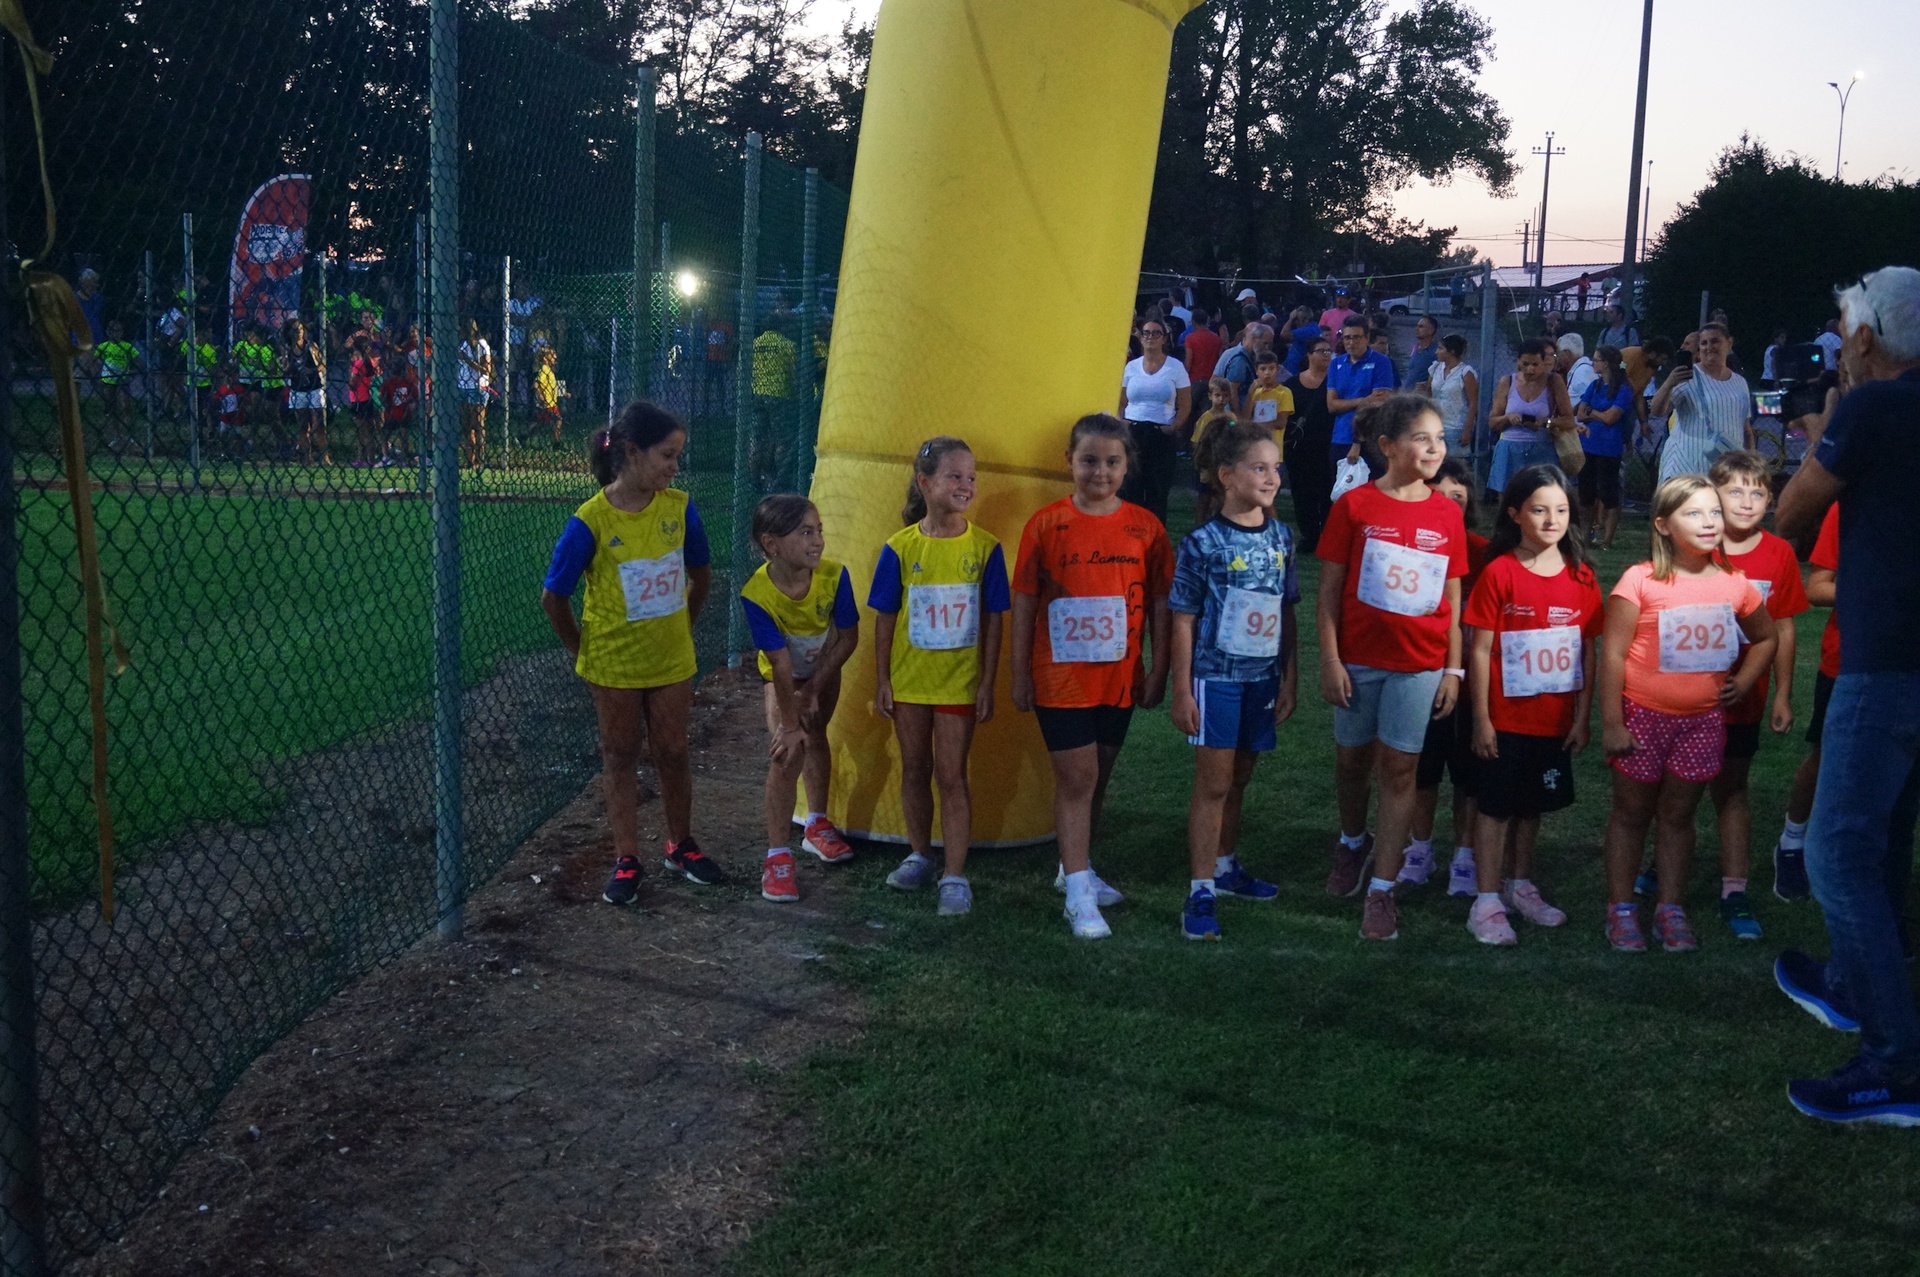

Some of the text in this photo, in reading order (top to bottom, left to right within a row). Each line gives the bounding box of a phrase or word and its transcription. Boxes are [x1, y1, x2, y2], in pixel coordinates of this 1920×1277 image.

[251, 224, 289, 235] PDISIC
[638, 569, 680, 602] 257
[1384, 564, 1420, 595] 53
[925, 603, 968, 629] 117
[1063, 616, 1115, 642] 253
[1246, 611, 1278, 638] 92
[1675, 623, 1727, 651] 292
[1519, 646, 1571, 675] 106
[1847, 1087, 1890, 1105] HOKA
